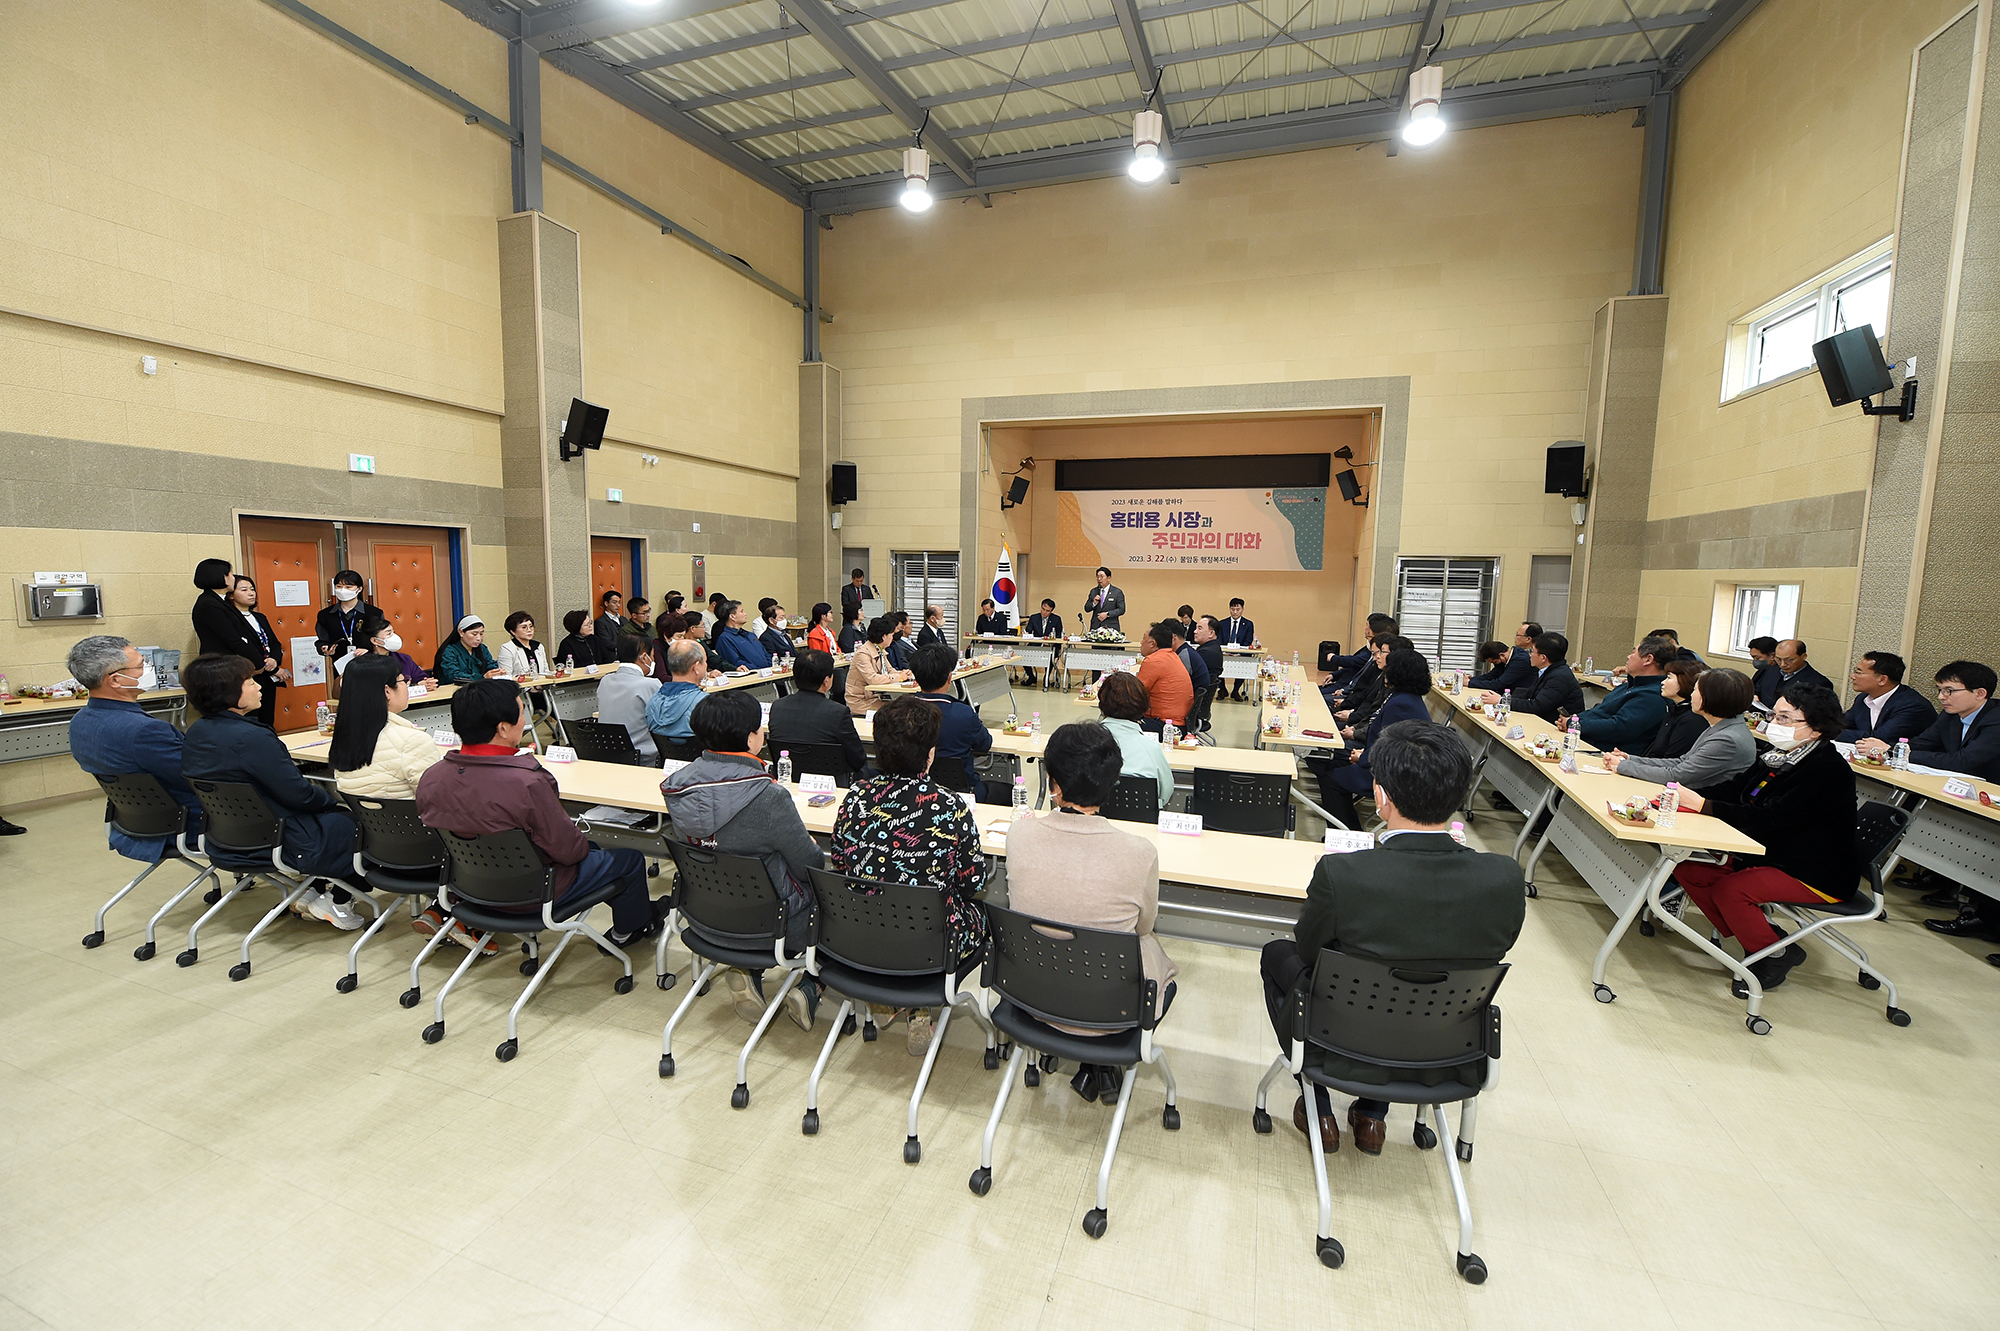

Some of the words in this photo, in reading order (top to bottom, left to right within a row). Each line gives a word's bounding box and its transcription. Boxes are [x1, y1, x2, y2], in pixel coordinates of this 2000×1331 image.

[1146, 498, 1163, 506] 김해를
[1110, 511, 1160, 529] 홍태용
[1165, 511, 1213, 529] 시장과
[1152, 532, 1221, 550] 주민과의
[1225, 532, 1262, 550] 대화
[1128, 555, 1145, 563] 2023.
[1180, 556, 1198, 564] 불암동
[1200, 556, 1239, 564] 행정복지센터
[887, 809, 924, 831] Macaw
[891, 848, 929, 859] Macaw
